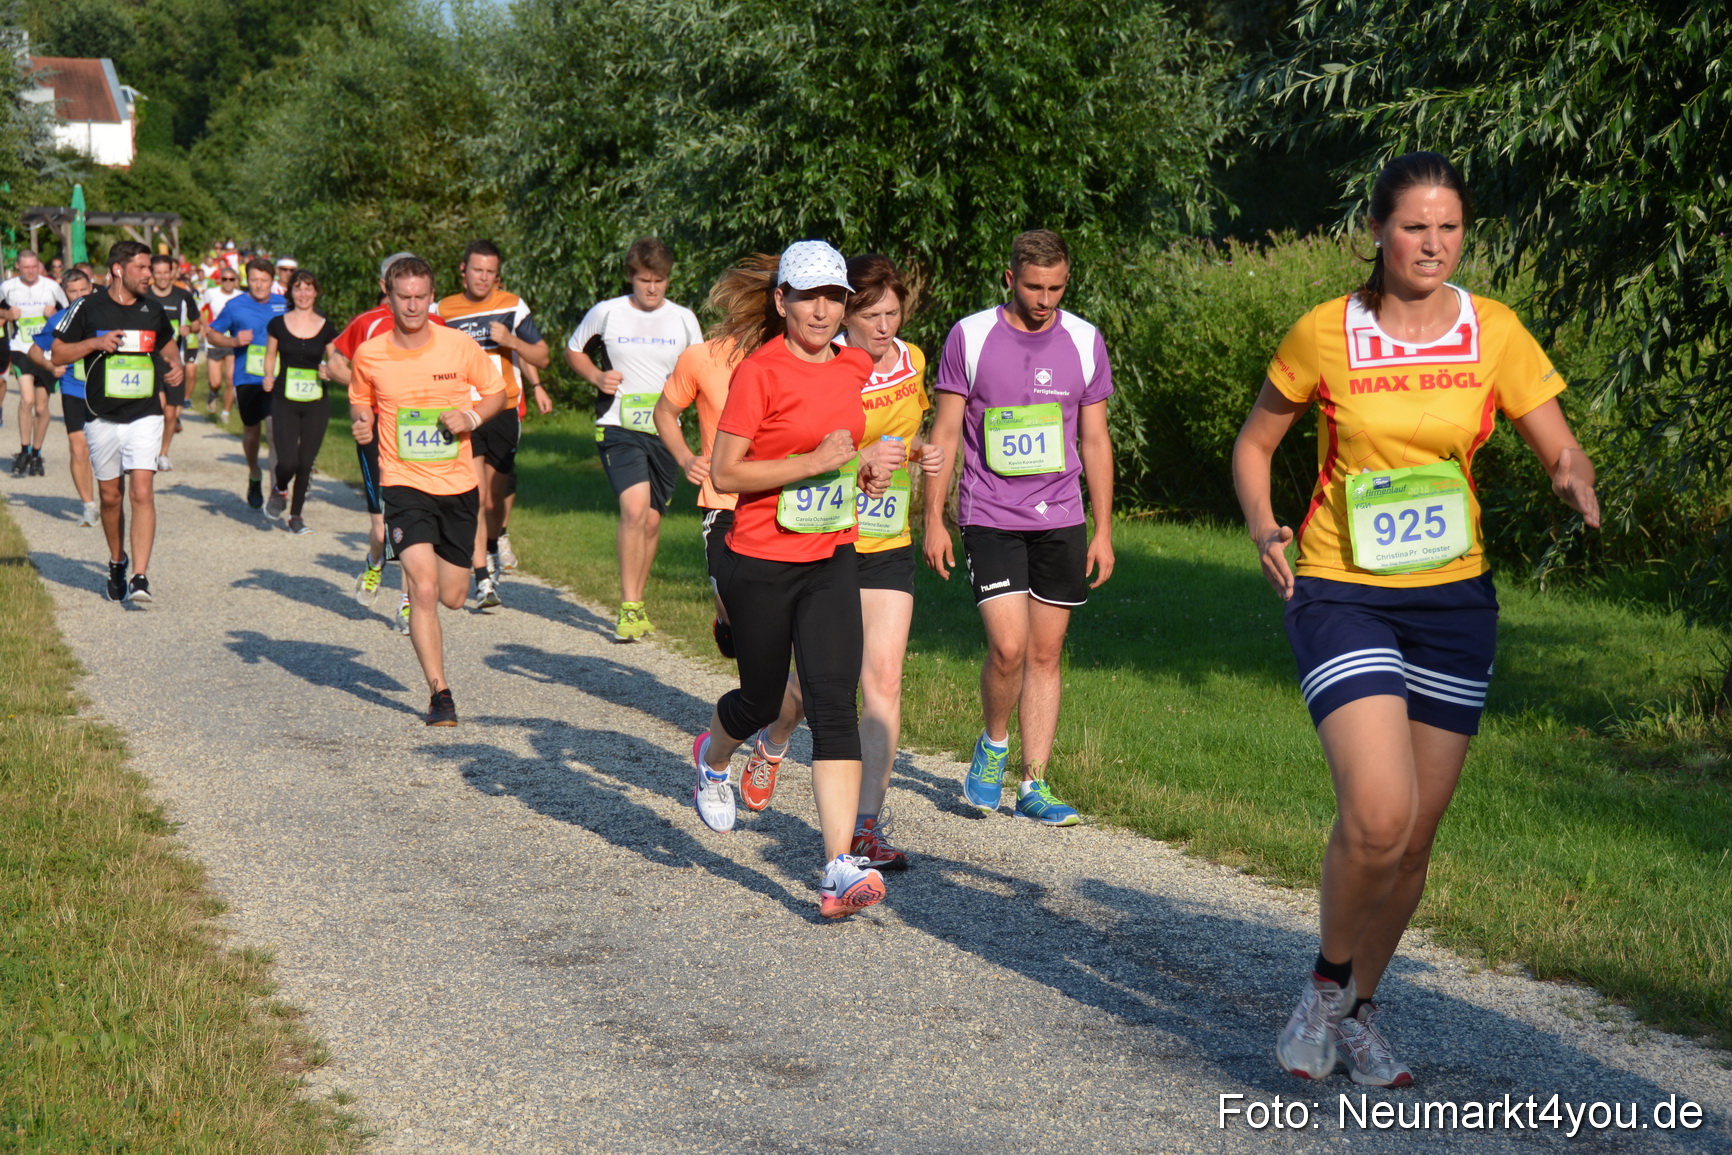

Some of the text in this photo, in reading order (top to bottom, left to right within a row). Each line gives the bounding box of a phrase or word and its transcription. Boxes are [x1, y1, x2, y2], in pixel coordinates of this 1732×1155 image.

[618, 337, 676, 345] DELPHI
[121, 373, 140, 386] 44
[432, 373, 458, 381] THULE
[1349, 369, 1482, 395] MAX BÖGL
[295, 382, 316, 393] 127
[862, 395, 893, 410] MAX
[632, 411, 652, 425] 27
[404, 429, 454, 446] 1449
[1002, 432, 1045, 456] 501
[796, 485, 844, 511] 974
[1365, 484, 1407, 497] firmenlauf
[1408, 485, 1430, 495] 2015
[857, 493, 897, 518] 926
[1373, 504, 1447, 546] 925
[1376, 551, 1408, 561] Christina
[1422, 545, 1451, 556] Oepster
[981, 578, 1010, 592] hummel
